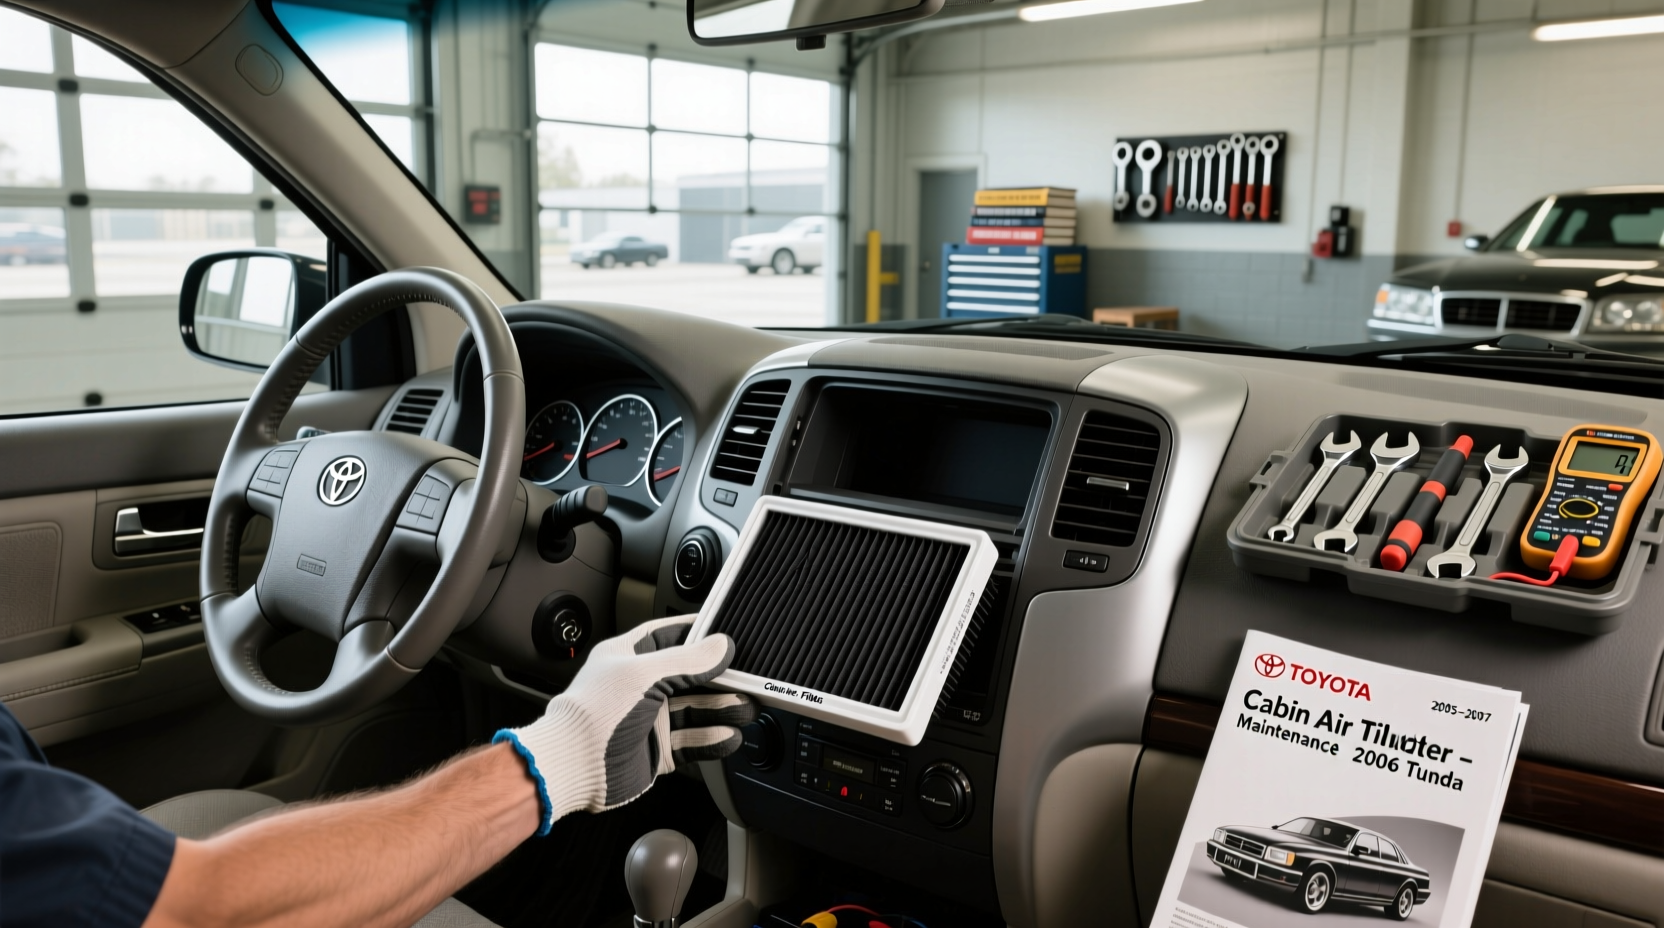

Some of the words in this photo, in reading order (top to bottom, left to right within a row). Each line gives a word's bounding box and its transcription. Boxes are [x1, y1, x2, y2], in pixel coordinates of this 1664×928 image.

[1291, 663, 1371, 702] TOYOTA
[1243, 689, 1311, 725] Cabin
[1313, 709, 1354, 737] Air
[1236, 713, 1340, 756] Maintenance
[1352, 746, 1400, 773] 2006
[1407, 760, 1464, 791] Tunda
